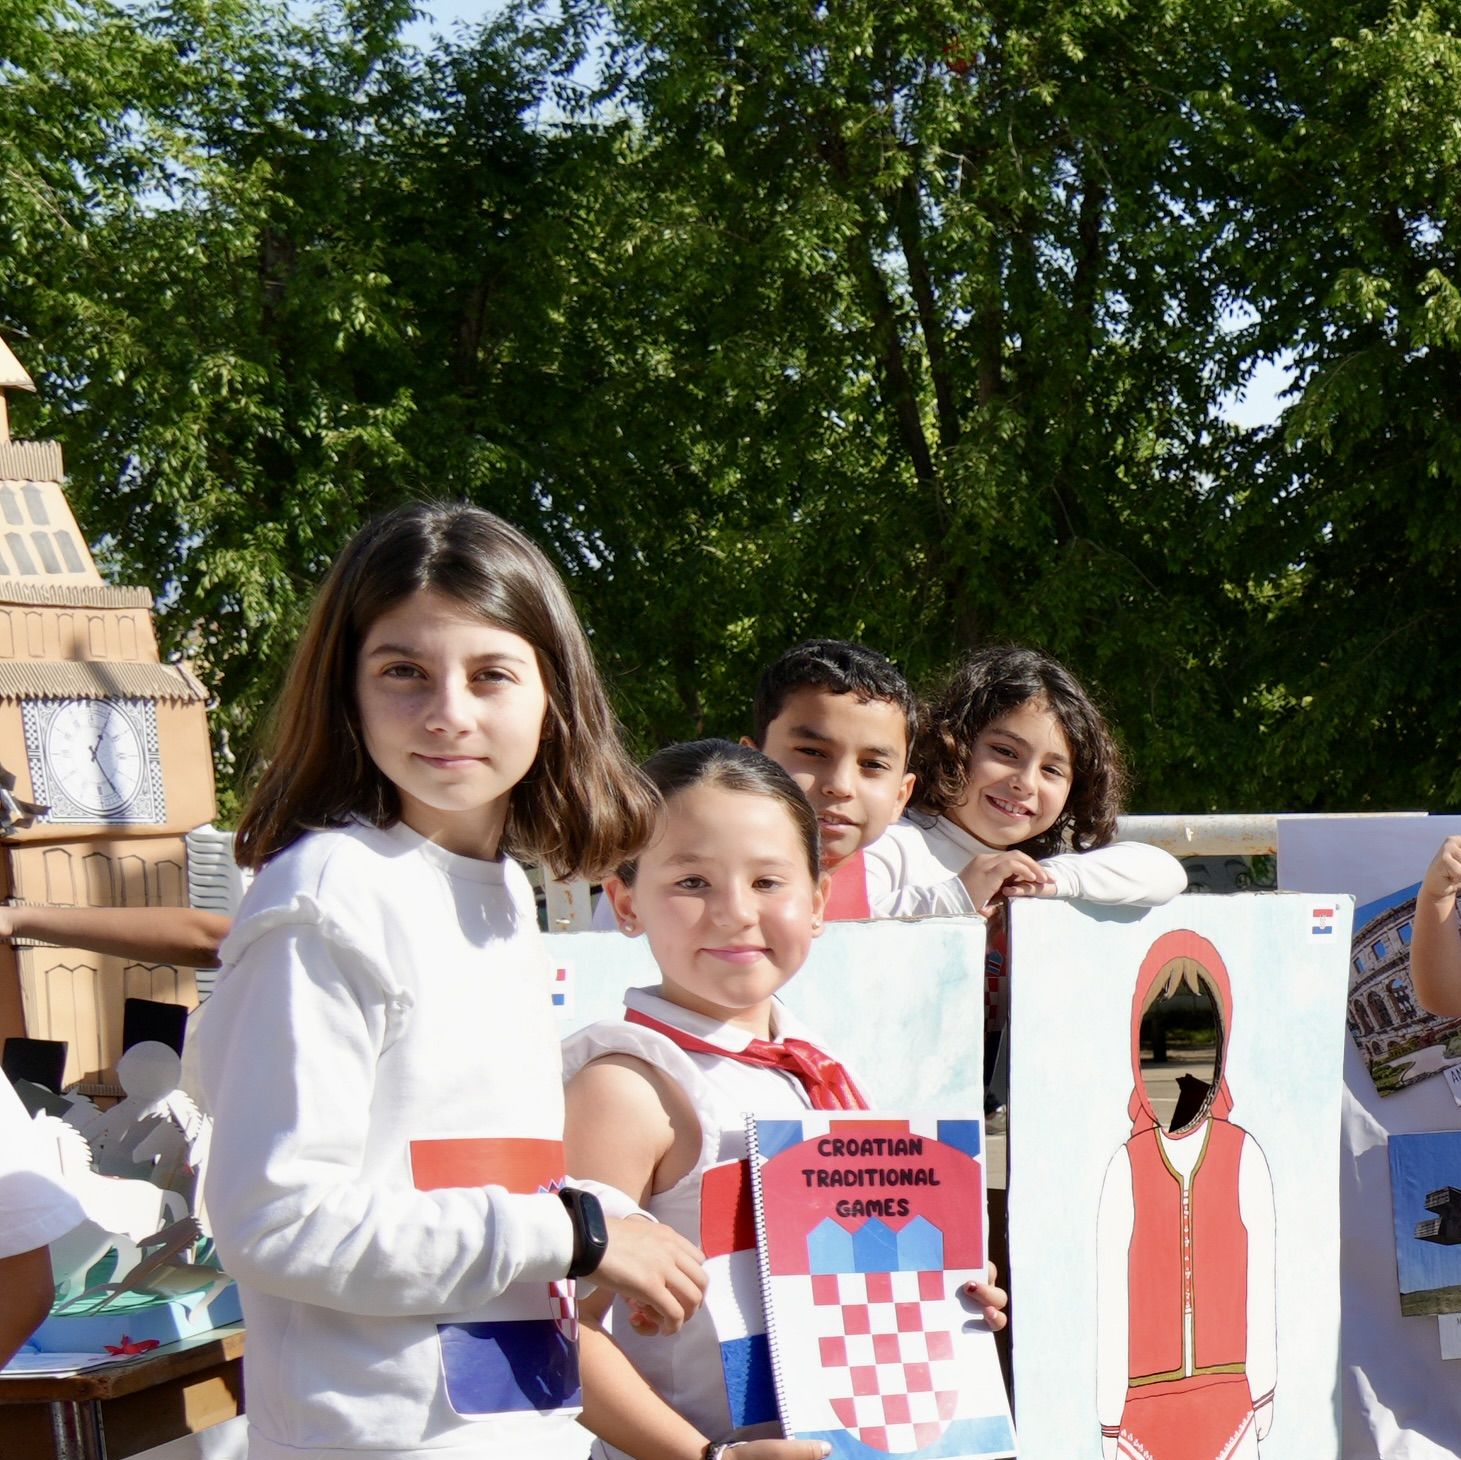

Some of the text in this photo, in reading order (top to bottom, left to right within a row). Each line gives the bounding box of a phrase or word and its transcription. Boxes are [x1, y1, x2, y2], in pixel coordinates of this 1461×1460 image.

[818, 1138, 923, 1157] CROATIAN
[802, 1168, 940, 1188] TRADITIONAL
[836, 1198, 910, 1218] GAMES
